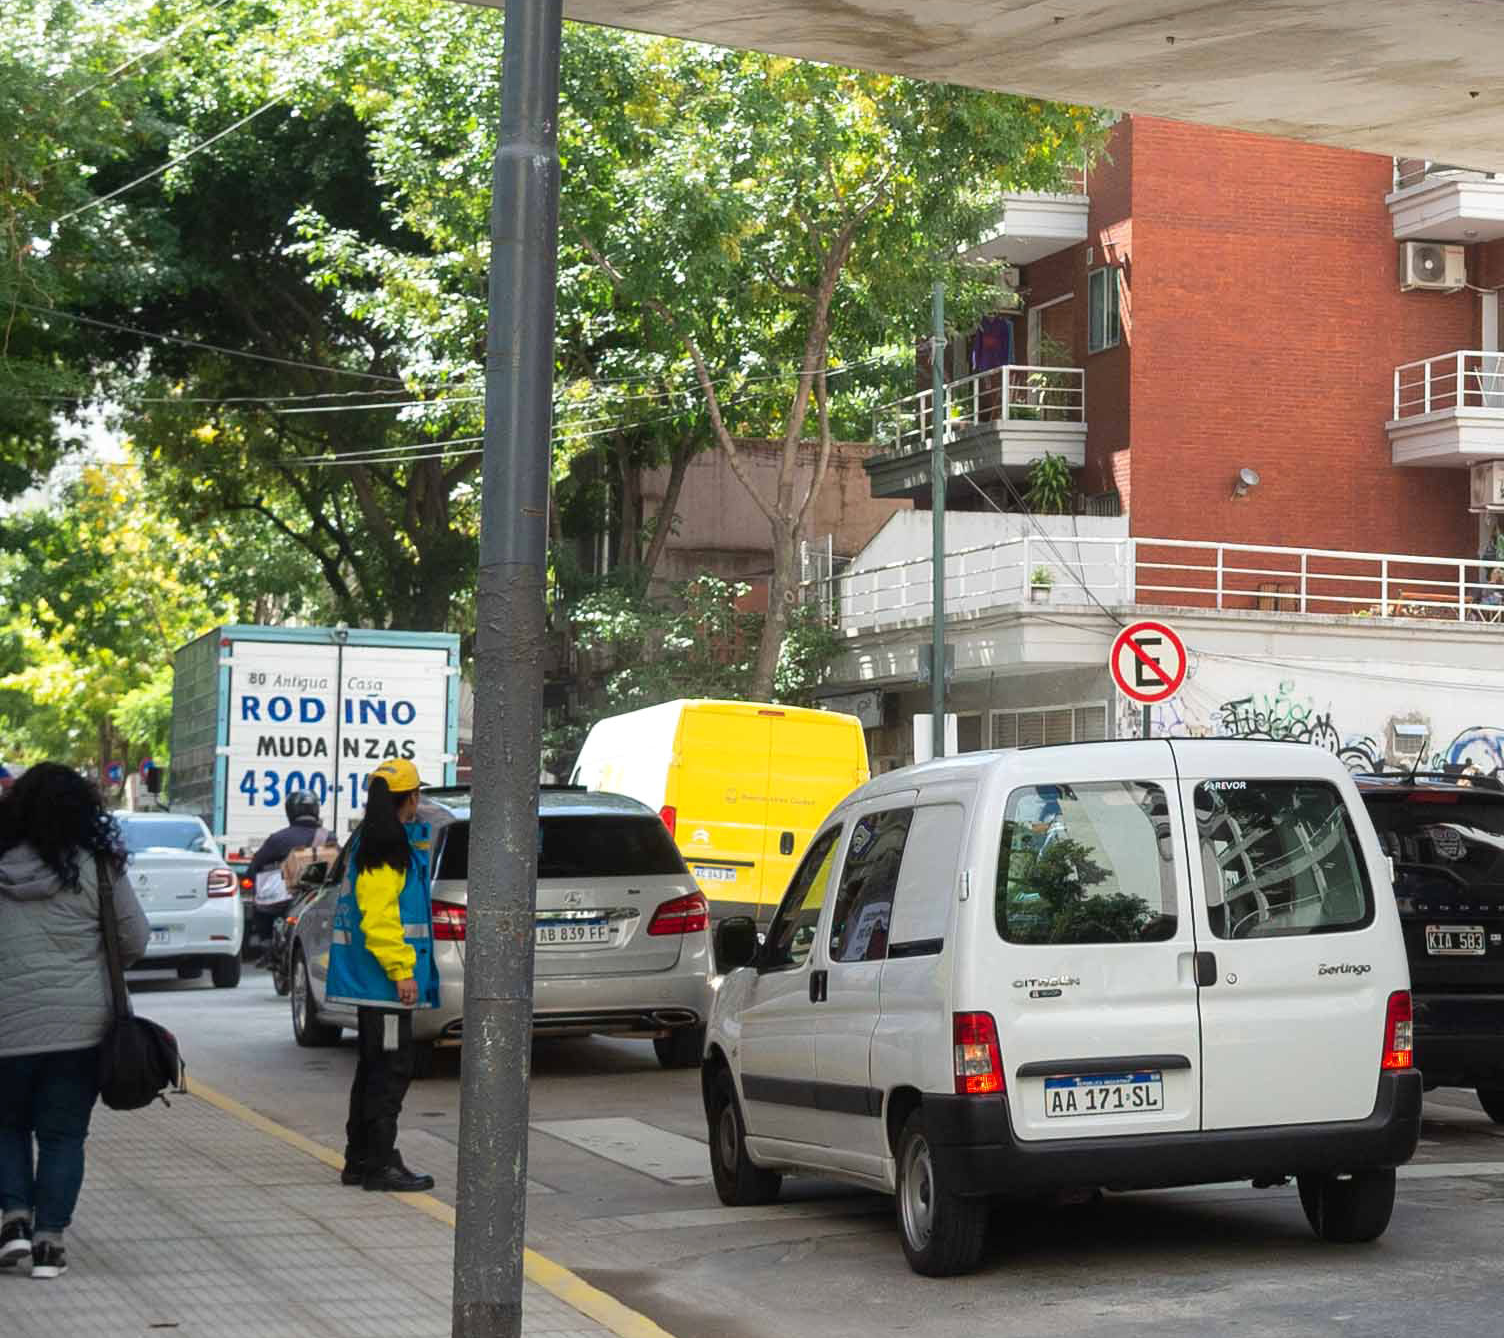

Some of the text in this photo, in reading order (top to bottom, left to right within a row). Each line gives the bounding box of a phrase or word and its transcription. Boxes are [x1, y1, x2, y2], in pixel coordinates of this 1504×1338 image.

[1134, 636, 1165, 688] E
[273, 676, 329, 693] Antigua
[347, 676, 384, 692] Casa
[560, 926, 585, 941] 839
[1428, 933, 1484, 950] KIA 583
[1051, 1084, 1158, 1113] AA 171 SL
